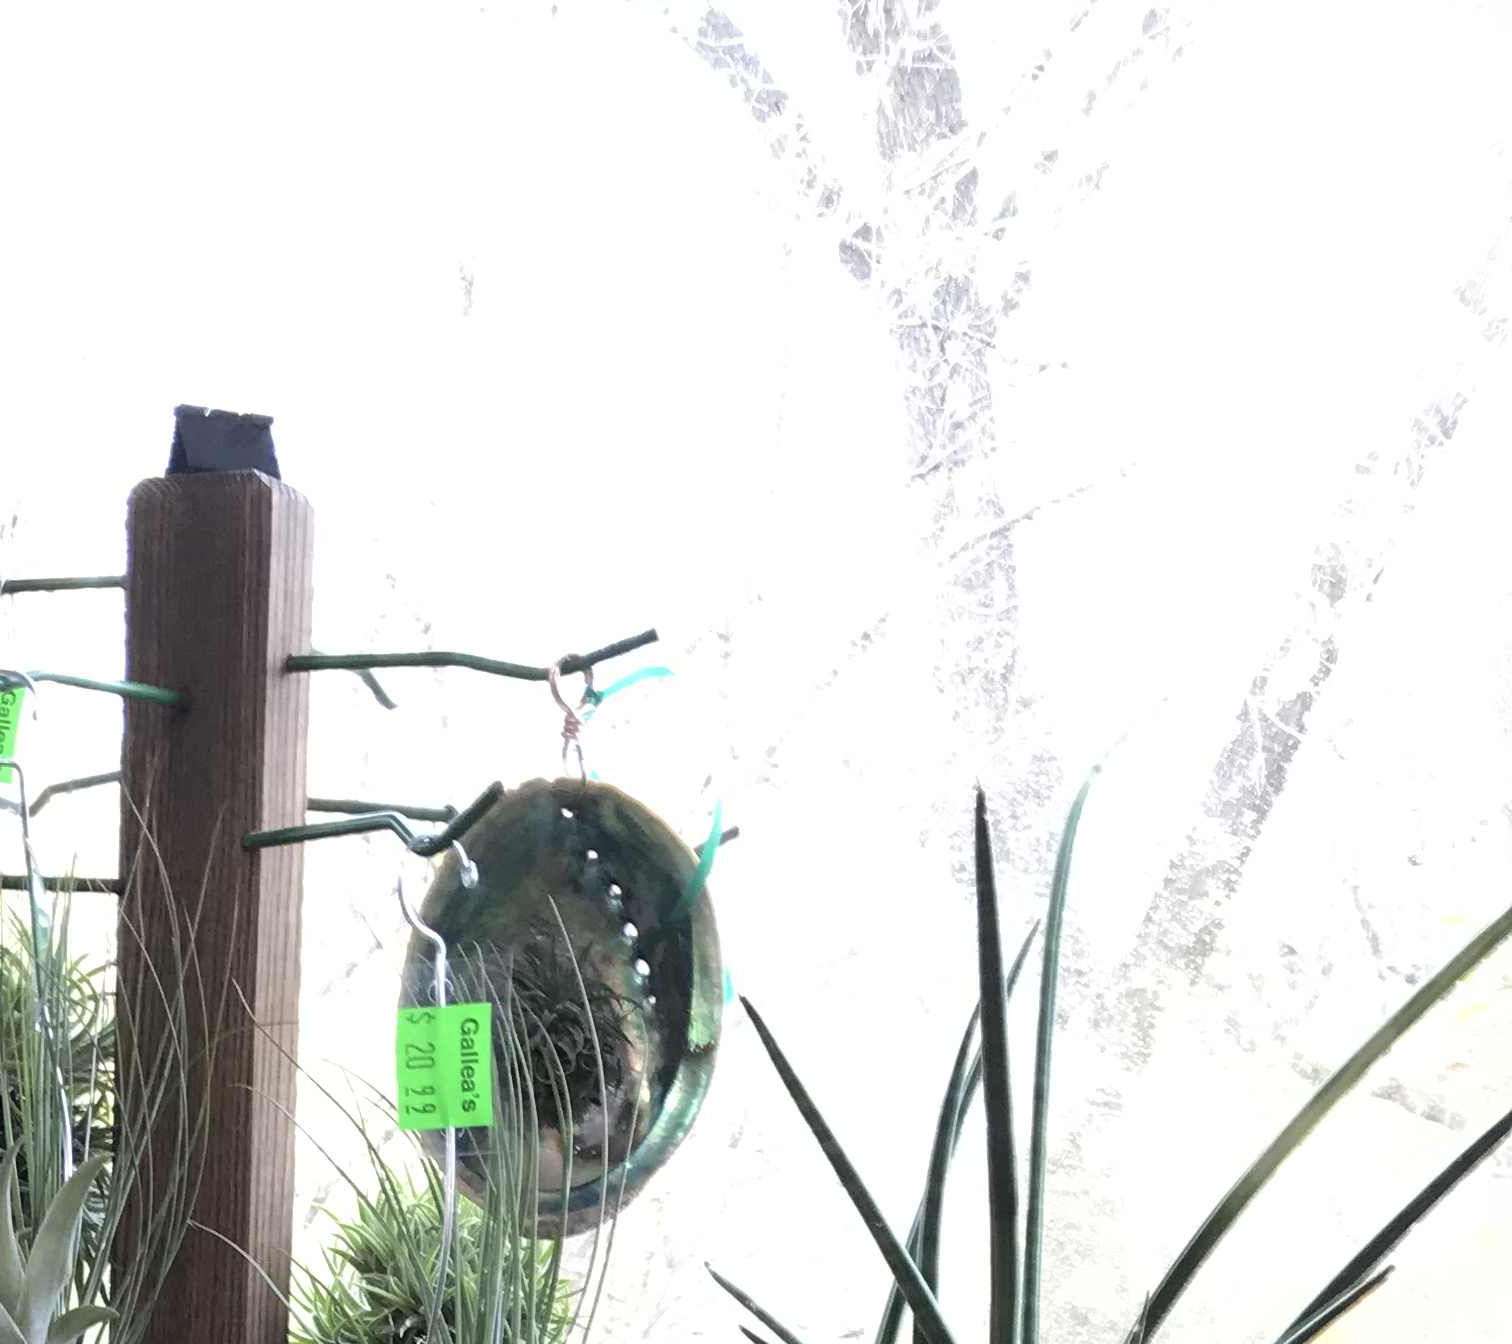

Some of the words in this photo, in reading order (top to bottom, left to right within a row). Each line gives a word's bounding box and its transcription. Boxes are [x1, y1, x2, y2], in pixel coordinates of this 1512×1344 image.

[406, 1011, 436, 1024] $
[405, 1043, 436, 1069] 20
[460, 1017, 480, 1112] Gallea's
[405, 1085, 437, 1115] 99
